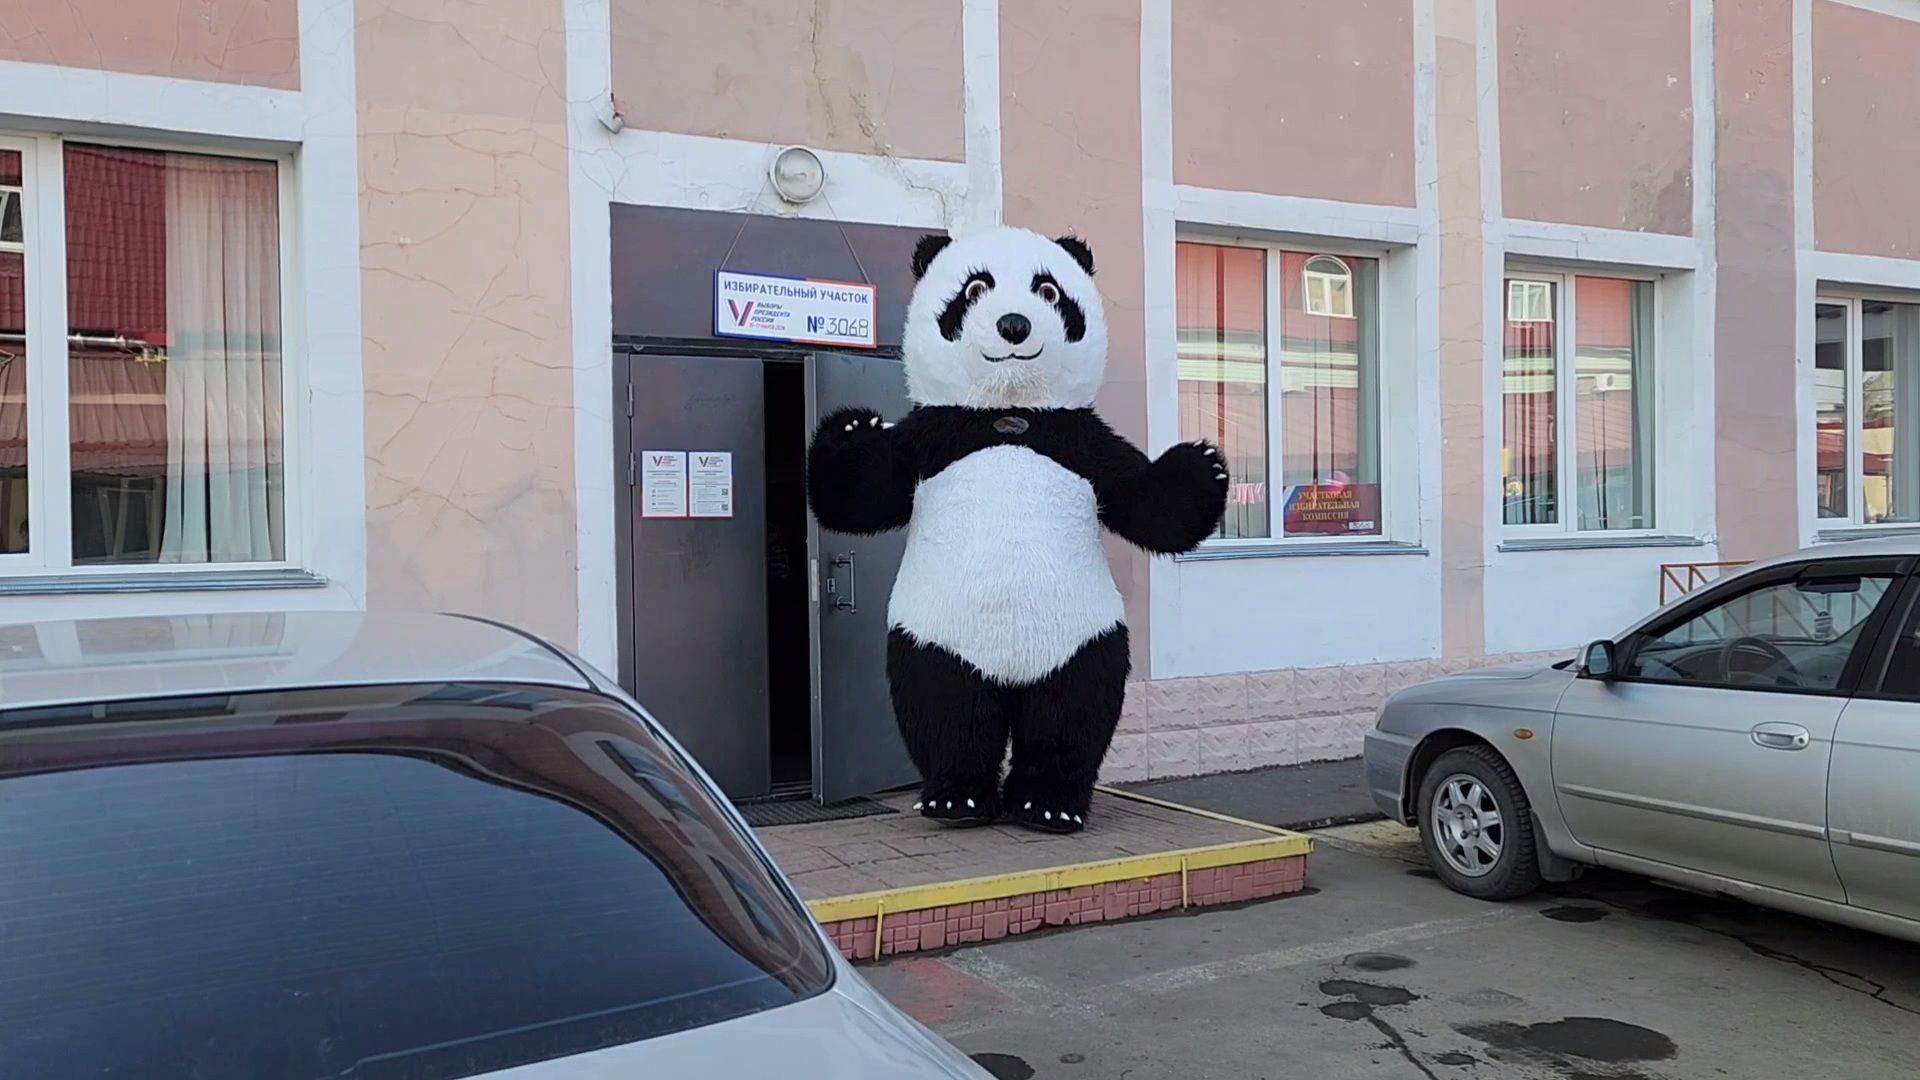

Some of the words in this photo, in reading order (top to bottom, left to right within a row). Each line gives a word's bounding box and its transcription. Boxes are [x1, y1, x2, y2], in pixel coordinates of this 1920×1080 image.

[724, 280, 817, 299] ИЗБИРАТЕЛЬНЫЙ
[820, 289, 868, 304] УЧАСТОК
[826, 317, 869, 338] 3068
[1298, 490, 1352, 499] УЧАСТКОВАЯ
[1288, 501, 1360, 511] ИЗБИРАТЕЛЬНАЯ
[1302, 511, 1349, 521] КОМИССИЯ
